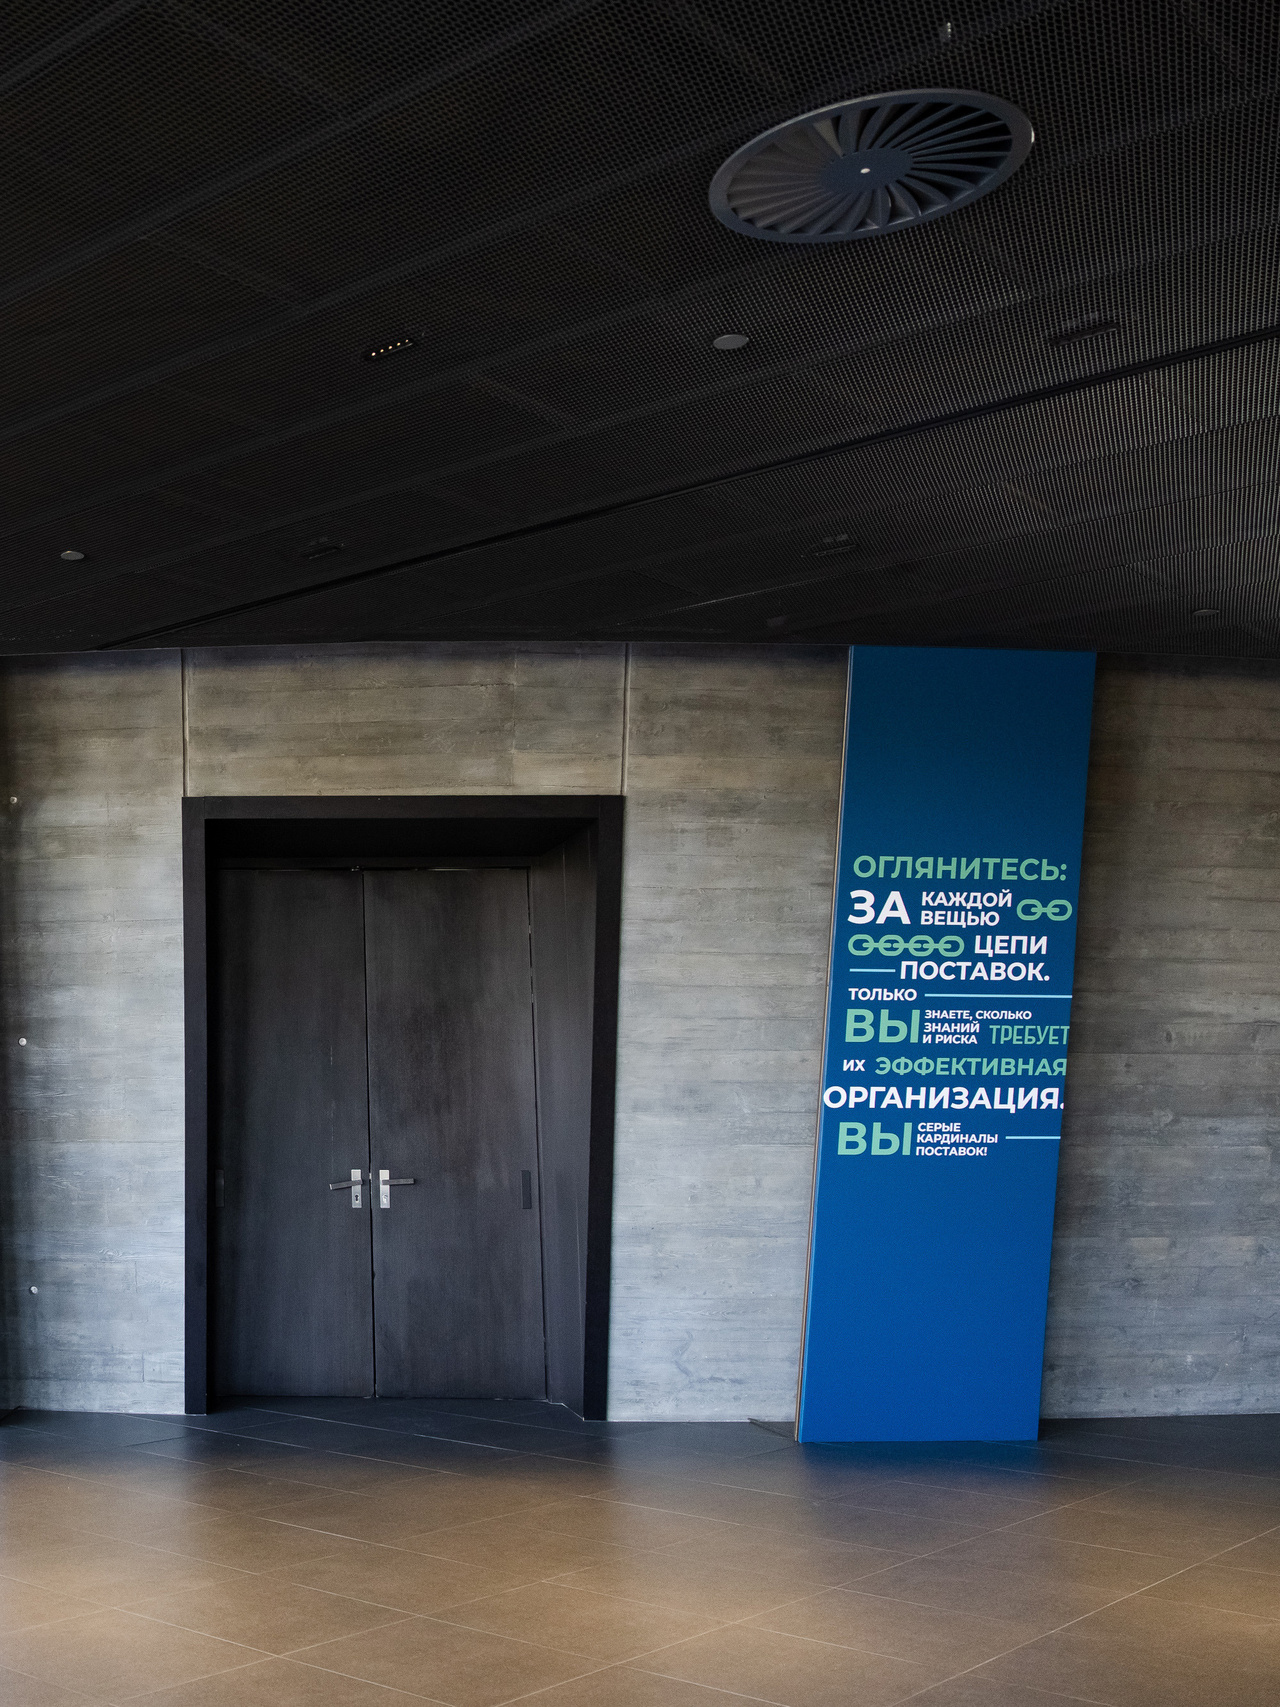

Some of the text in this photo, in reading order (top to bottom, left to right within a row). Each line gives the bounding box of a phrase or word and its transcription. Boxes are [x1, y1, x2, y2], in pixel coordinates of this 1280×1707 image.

[853, 855, 1067, 881] ОГЛЯНИТЕСЬ:
[847, 889, 911, 925] ЗА
[921, 889, 1012, 909] КАЖДОЙ
[921, 911, 999, 928] ВЕЩЬЮ
[974, 935, 1047, 957] ЦЕПИ
[900, 961, 1050, 981] ПОСТАВОК.
[848, 988, 917, 1001] ТОЛЬКО
[845, 1008, 921, 1043] ВЫ
[924, 1010, 1032, 1021] ЗНАЕТЕ, СКОЛЬКО
[923, 1020, 980, 1033] ЗНАНИЙ
[989, 1024, 1070, 1045] ТРЕБУЕТ
[923, 1034, 977, 1045] И РИСКА
[842, 1056, 1067, 1076] ИХ ЭФФЕКТИВНАЯ
[823, 1085, 1064, 1114] ОРГАНИЗАЦИЯ.
[917, 1123, 961, 1132] СЕРЫЕ
[837, 1122, 913, 1156] ВЫ
[916, 1133, 998, 1144] КАРДИНАЛЫ
[915, 1146, 988, 1157] ПОСТАВОК!
